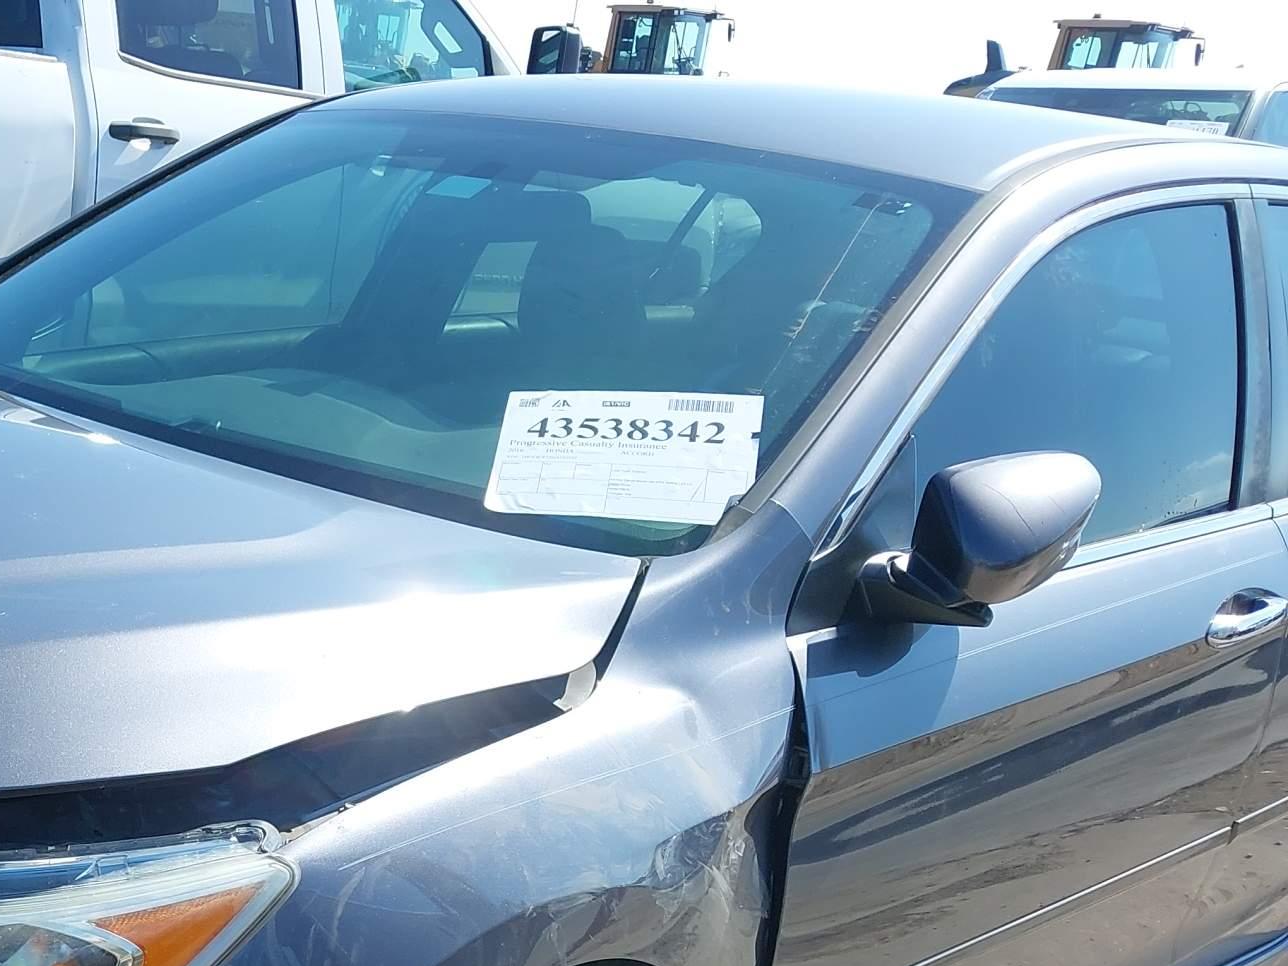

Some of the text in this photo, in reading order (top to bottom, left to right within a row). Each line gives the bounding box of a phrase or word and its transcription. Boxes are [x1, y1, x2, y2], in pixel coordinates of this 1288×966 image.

[527, 416, 726, 444] 43538342
[509, 439, 668, 450] Progressive Casualty Insurance
